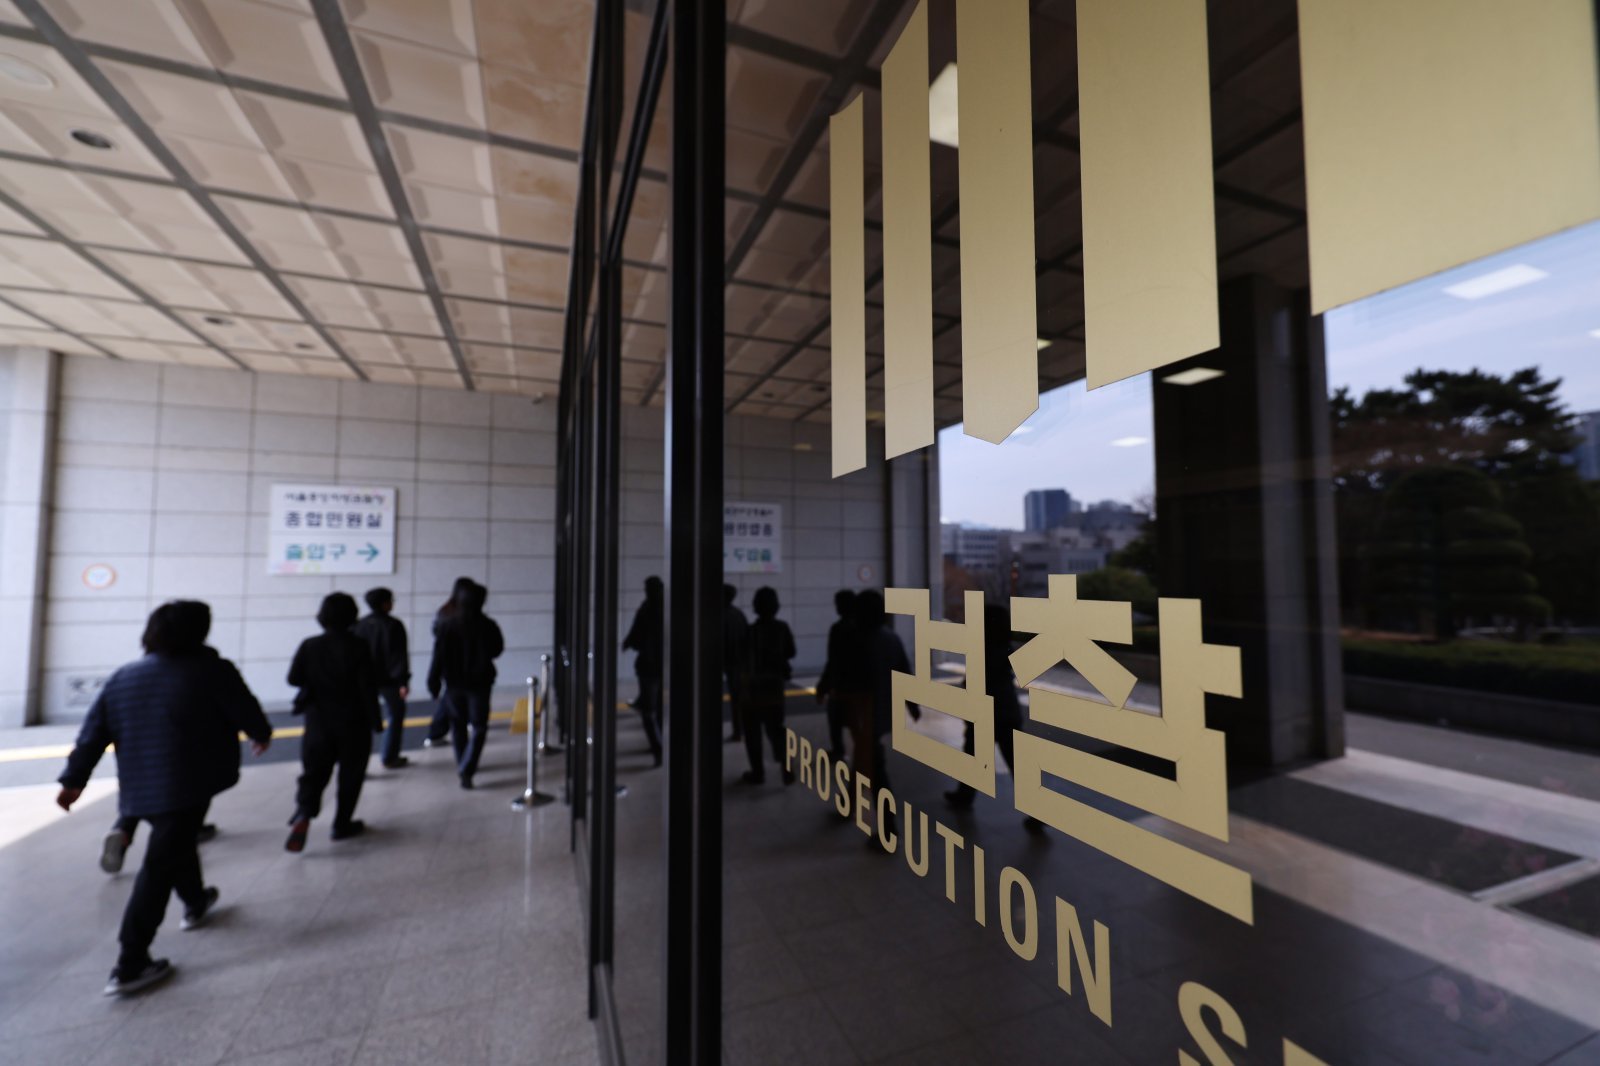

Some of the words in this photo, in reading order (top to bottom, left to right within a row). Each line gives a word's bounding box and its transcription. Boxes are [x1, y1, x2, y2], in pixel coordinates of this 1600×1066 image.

[285, 511, 383, 529] 종합민원실
[286, 543, 347, 561] 출입구
[884, 573, 1254, 926] 검찰
[785, 728, 1112, 1028] PROSECUTION
